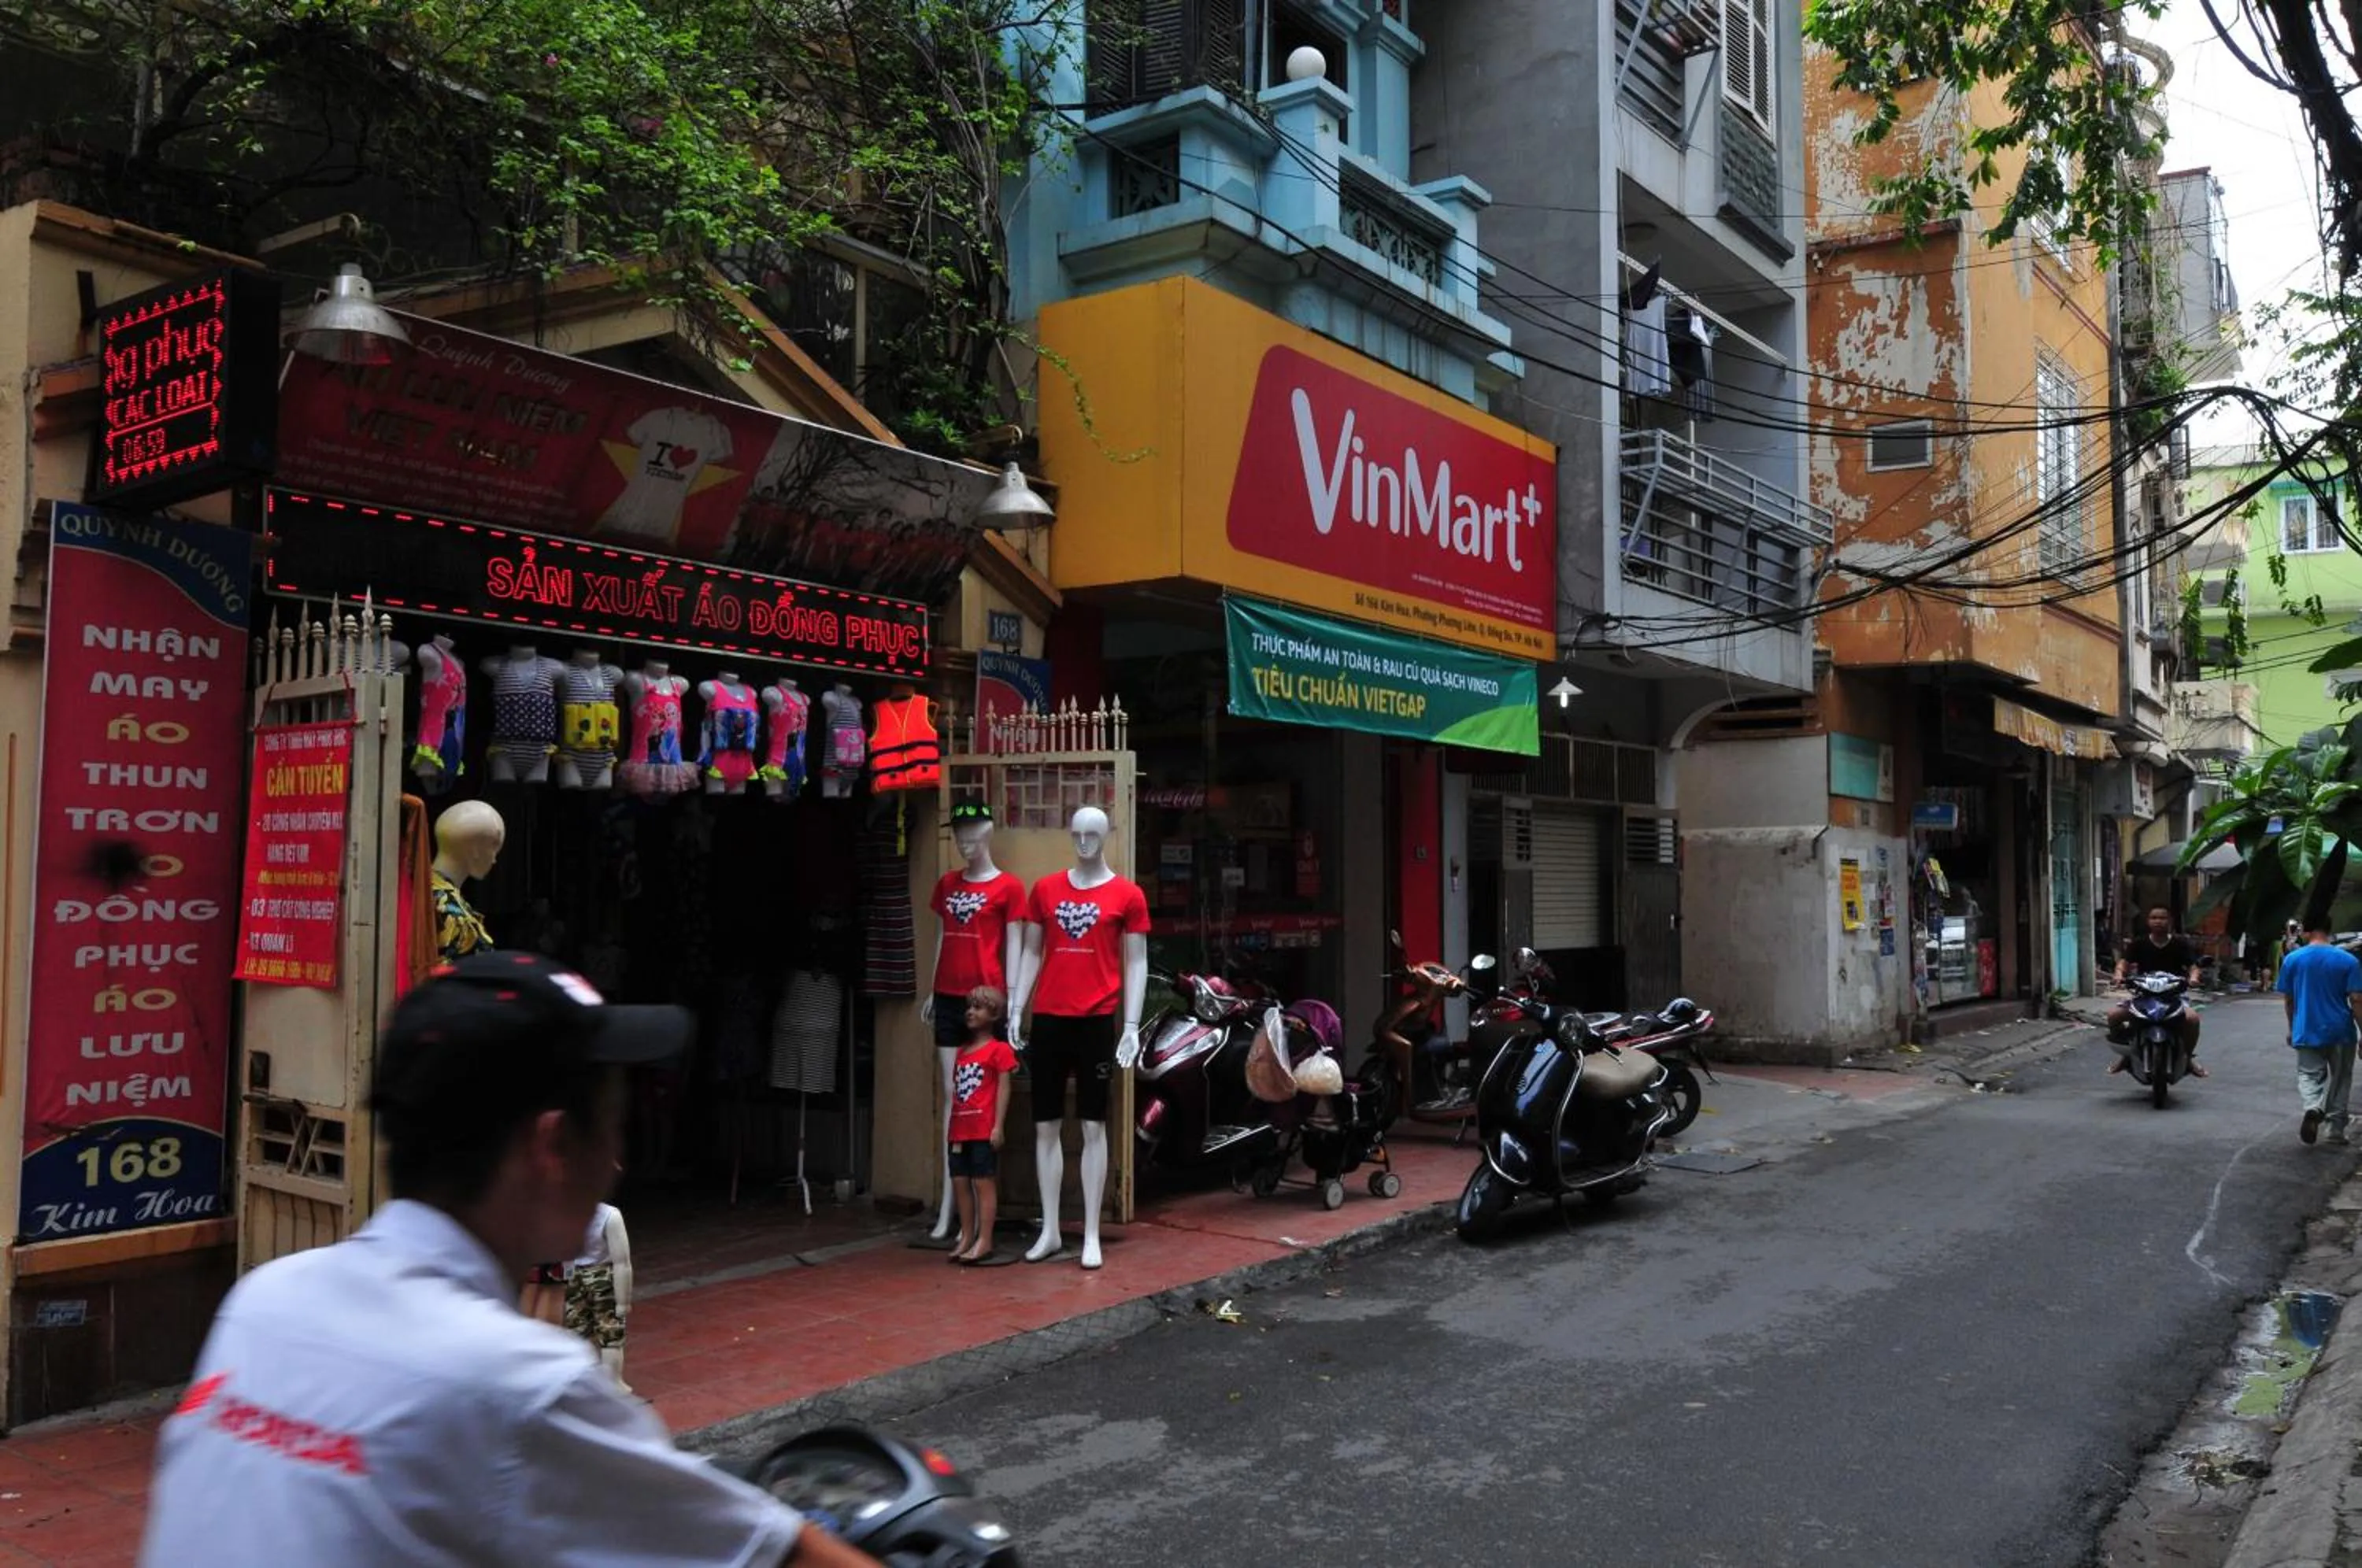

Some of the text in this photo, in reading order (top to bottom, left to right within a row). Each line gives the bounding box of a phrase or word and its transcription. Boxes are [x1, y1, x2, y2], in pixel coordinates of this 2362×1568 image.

[168, 538, 244, 613] DƯƠNG
[487, 546, 572, 607] SẢN
[692, 582, 741, 631] ÁO
[846, 615, 920, 665] PHỤC
[83, 623, 220, 662] NHẬN
[993, 616, 1018, 642] 168
[1251, 632, 1286, 658] THỰC
[1324, 648, 1339, 666] AN
[1342, 649, 1371, 672] TOÀN
[1373, 660, 1382, 674] &
[1383, 658, 1403, 677] RAU
[1442, 671, 1465, 691] SẠCH
[1467, 676, 1499, 696] VINECO
[90, 671, 209, 701] MAY
[1251, 664, 1292, 700] TIÊU
[1363, 685, 1426, 718] VIETGAP
[107, 713, 190, 744] ÁO
[82, 762, 207, 790] THUN
[65, 808, 220, 834] TRƠN
[54, 886, 220, 923] ĐỒNG
[75, 943, 198, 972] PHỤC
[93, 983, 177, 1012] ÁO
[80, 1031, 186, 1059] LƯU
[66, 1074, 192, 1108] NIỆM
[76, 1137, 183, 1188] 168
[30, 1189, 215, 1236] Kim Hoa
